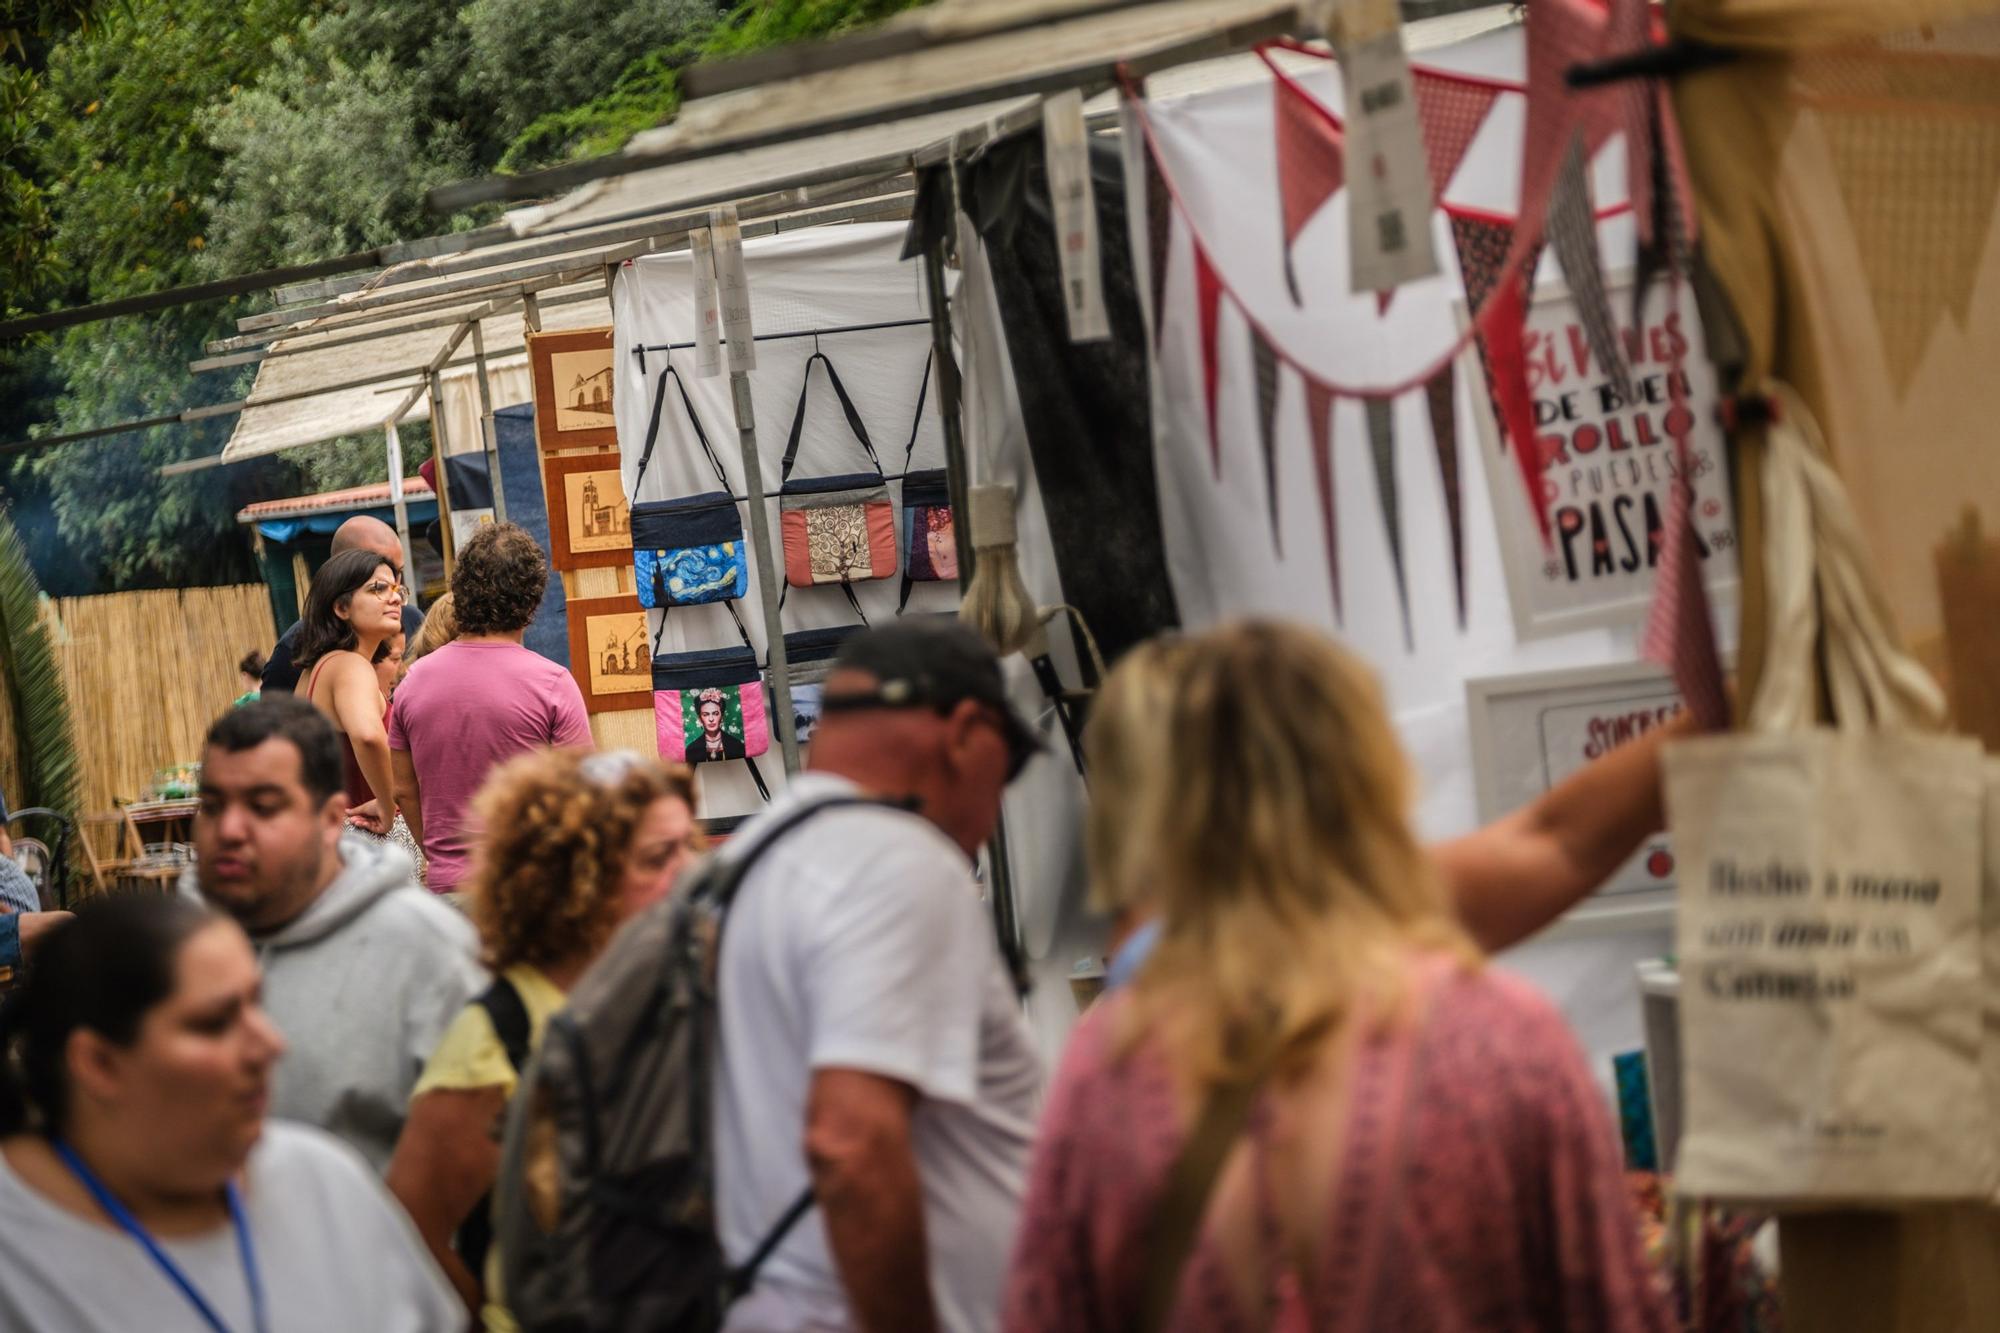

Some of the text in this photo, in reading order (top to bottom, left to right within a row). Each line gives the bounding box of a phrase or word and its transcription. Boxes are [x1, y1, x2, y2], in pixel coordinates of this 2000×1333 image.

[1533, 392, 1584, 426] DE
[1536, 405, 1695, 469] ROLLO
[1570, 451, 1681, 497] PUEDES
[1556, 490, 1710, 582] PASA
